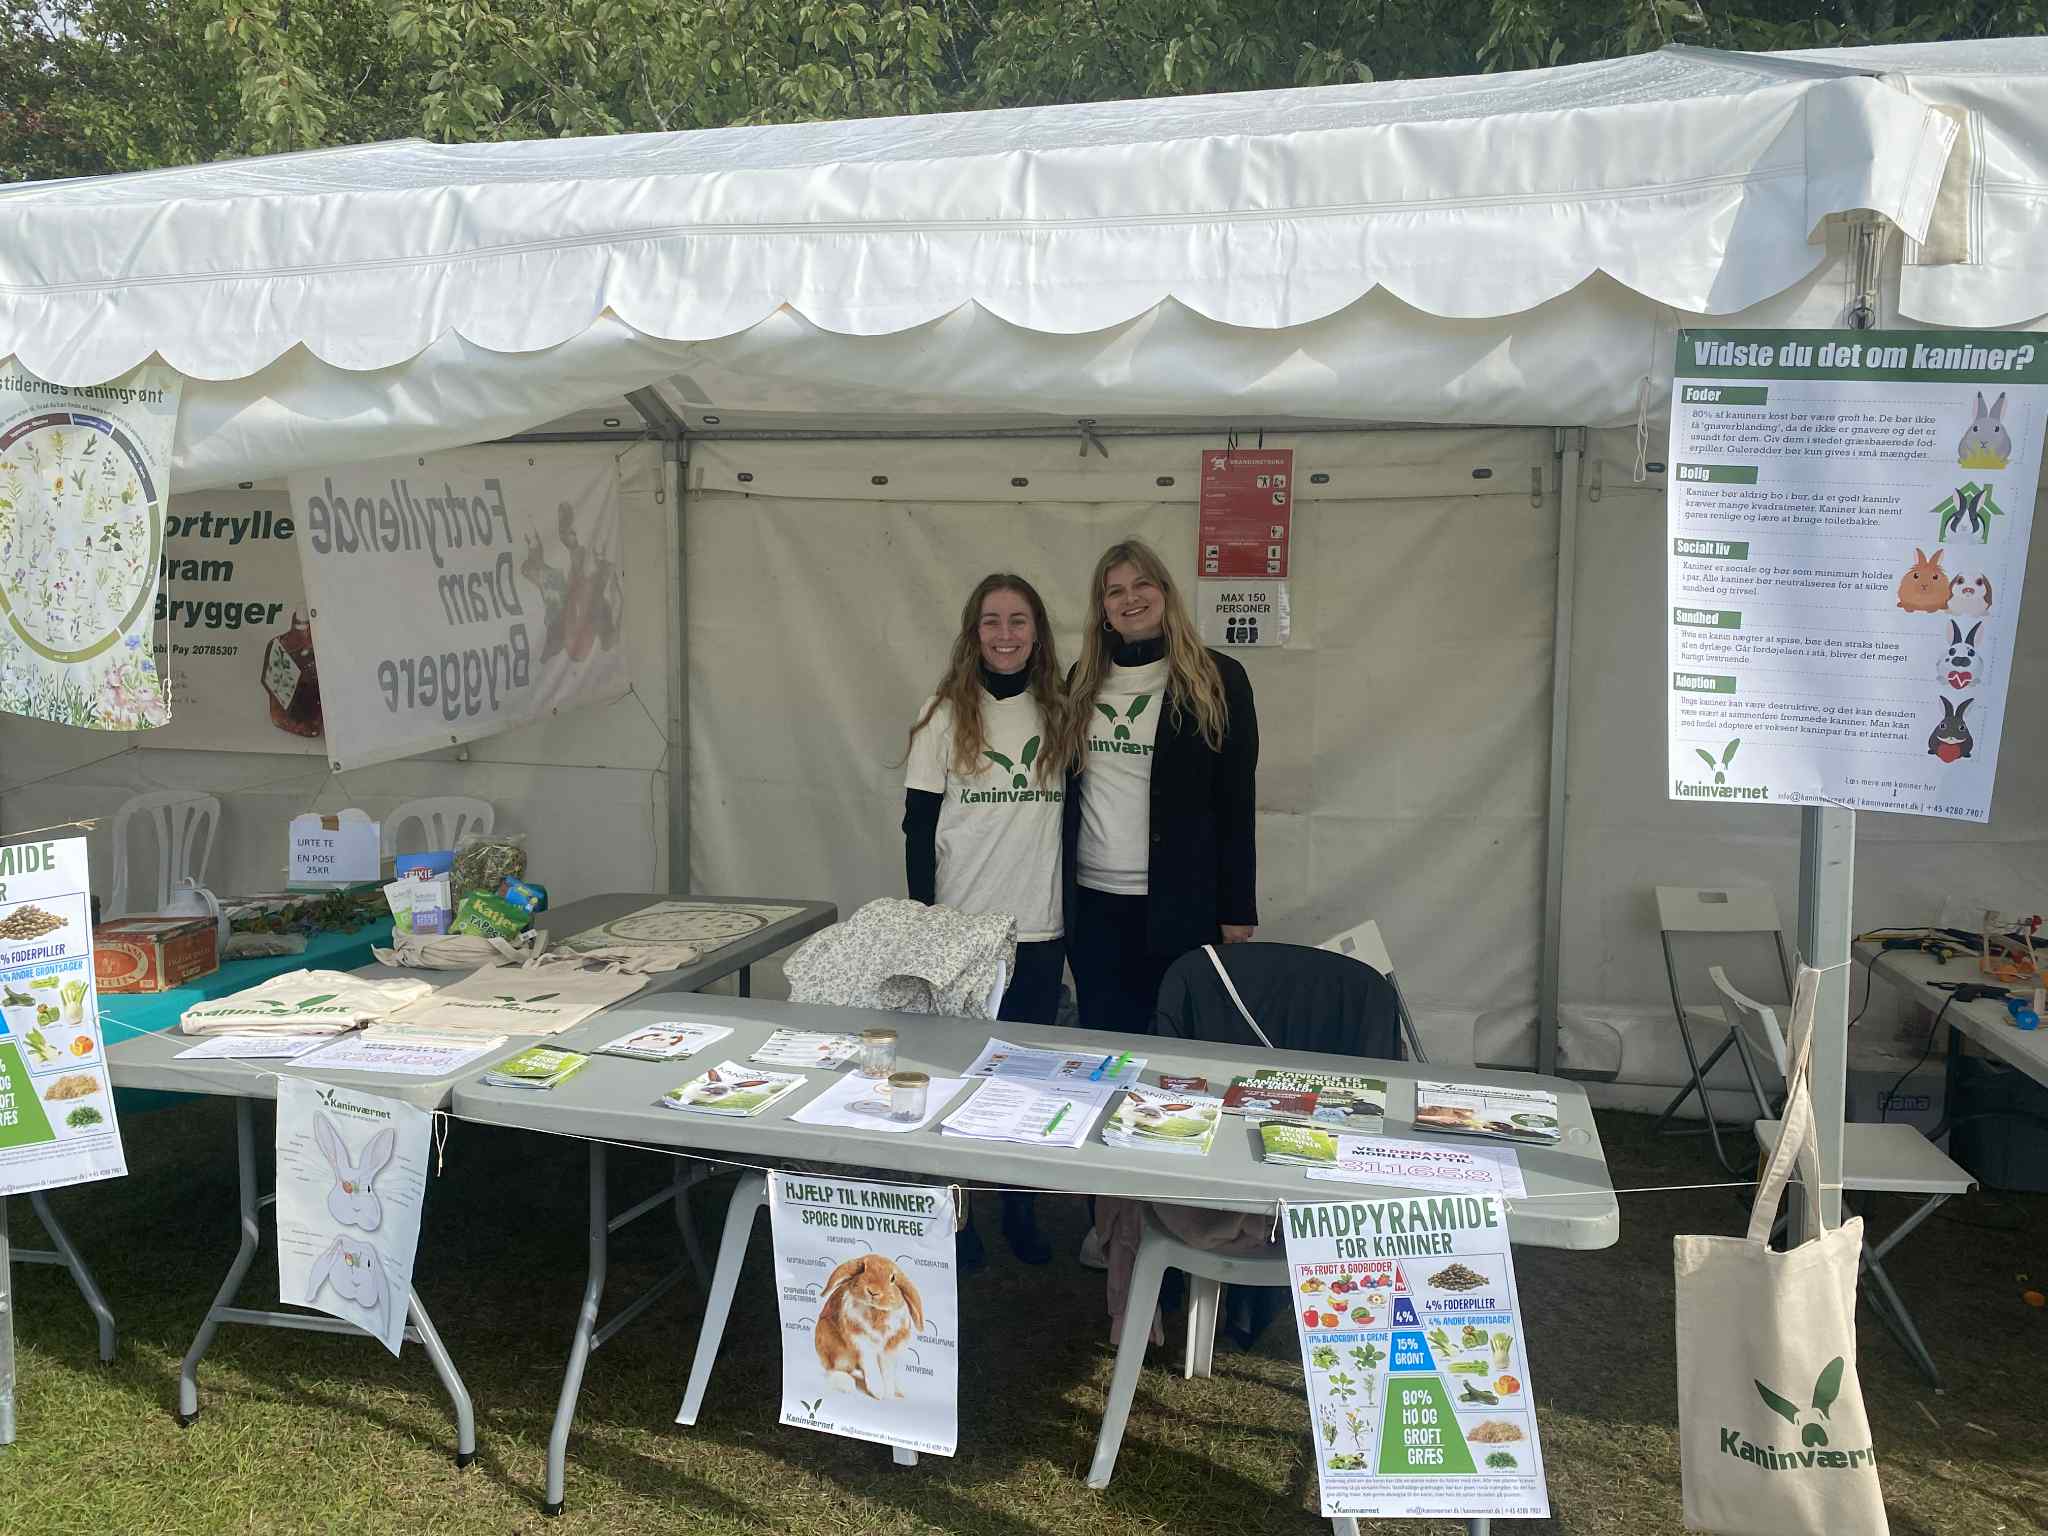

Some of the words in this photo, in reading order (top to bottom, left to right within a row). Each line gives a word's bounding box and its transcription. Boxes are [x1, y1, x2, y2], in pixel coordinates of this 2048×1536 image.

[1694, 341, 1774, 367] Vidste
[1779, 342, 1813, 367] du
[1817, 342, 1862, 368] det
[1866, 349, 1908, 369] om
[1912, 343, 2035, 371] kaniner?
[1686, 387, 1722, 402] Foder
[1769, 412, 1789, 421] kost
[1791, 413, 1807, 421] bør
[1896, 415, 1912, 423] bør
[1915, 415, 1936, 424] ikke
[1815, 425, 1836, 433] ikke
[1851, 427, 1889, 437] gnavere
[1907, 427, 1924, 436] det
[1722, 433, 1736, 442] for
[1763, 434, 1780, 443] Giv
[1782, 436, 1804, 444] dem
[1812, 436, 1842, 445] stedet
[1727, 446, 1782, 455] Gulerødder
[1785, 447, 1801, 455] bør
[1804, 448, 1822, 456] kun
[1825, 449, 1850, 459] gives
[1858, 448, 1877, 457] små
[1680, 466, 1710, 482] Bolig
[1686, 487, 1719, 498] Kaniner
[1721, 488, 1737, 498] bør
[1739, 489, 1768, 501] aldrig
[1838, 494, 1860, 504] godt
[1685, 500, 1716, 508] kræver
[1718, 502, 1749, 512] mange
[1818, 504, 1857, 514] Kaniner
[1858, 506, 1876, 515] kan
[1878, 508, 1902, 516] nemt
[1710, 511, 1741, 522] renlige
[1757, 513, 1779, 522] lære
[1792, 516, 1822, 526] bruge
[164, 510, 295, 545] ortrylle
[1677, 539, 1713, 555] Socialt
[1715, 543, 1730, 556] liv
[1682, 561, 1713, 571] Kaniner
[1725, 564, 1757, 573] sociale
[1773, 566, 1790, 576] bør
[1792, 568, 1812, 576] som
[1815, 569, 1859, 578] minimum
[1861, 570, 1893, 580] holdes
[1721, 575, 1754, 585] kaniner
[1756, 576, 1772, 585] bør
[1774, 578, 1836, 588] neutraliseres
[1838, 580, 1852, 590] for
[1865, 582, 1889, 591] sikre
[1221, 592, 1244, 602] MAX
[1247, 592, 1266, 602] 150
[1215, 604, 1271, 613] PERSONER
[1676, 610, 1719, 625] Sundhed
[1732, 632, 1764, 644] nægter
[1805, 636, 1822, 646] bør
[1824, 638, 1842, 647] den
[1844, 639, 1873, 649] straks
[173, 644, 190, 656] Pay
[1829, 650, 1857, 660] bliver
[1860, 651, 1876, 661] det
[1878, 653, 1908, 664] meget
[1676, 674, 1716, 690] Adoption
[1822, 705, 1835, 715] og
[1837, 705, 1853, 714] det
[1855, 706, 1873, 715] kan
[1875, 707, 1916, 719] desuden
[1780, 712, 1828, 724] fremmede
[1870, 718, 1890, 728] Man
[1892, 720, 1910, 729] kan
[1800, 724, 1841, 737] kaninpar
[1843, 727, 1857, 737] fra
[1675, 779, 1769, 800] Kaninværnet
[323, 839, 335, 848] TE
[297, 854, 310, 863] EN
[312, 854, 336, 864] POSE
[12, 943, 66, 963] FODERPILLER
[330, 1098, 391, 1119] Kaninværnet
[1352, 1150, 1444, 1161] MOBILEPAY
[1355, 1146, 1387, 1154] VED
[1391, 1148, 1471, 1159] DONATION
[785, 1181, 834, 1203] HJÆLP
[837, 1188, 858, 1206] TIL
[861, 1189, 936, 1213] KANINER?
[841, 1214, 863, 1230] DIN
[866, 1216, 924, 1237] DYRLÆGE
[1288, 1197, 1498, 1239] MADPYRAMIDE
[1335, 1237, 1368, 1258] FOR
[1374, 1232, 1454, 1257] KANINER
[1314, 1264, 1338, 1275] FRUGT
[1340, 1263, 1345, 1273] &
[1348, 1261, 1392, 1274] GODBIDDER
[1425, 1300, 1442, 1311] 4%
[1443, 1298, 1496, 1310] FODERPILLER
[1396, 1311, 1413, 1323] 4%
[1396, 1338, 1419, 1351] 15%
[1395, 1352, 1425, 1365] GRØNT
[1403, 1390, 1432, 1405] 80%
[786, 1412, 834, 1430] Kaninværnet
[1403, 1408, 1419, 1425] HØ
[1422, 1408, 1438, 1424] OG
[1403, 1429, 1441, 1445] GROFT
[1407, 1448, 1444, 1465] GRÆS
[1337, 1505, 1380, 1514] Kaninværnet
